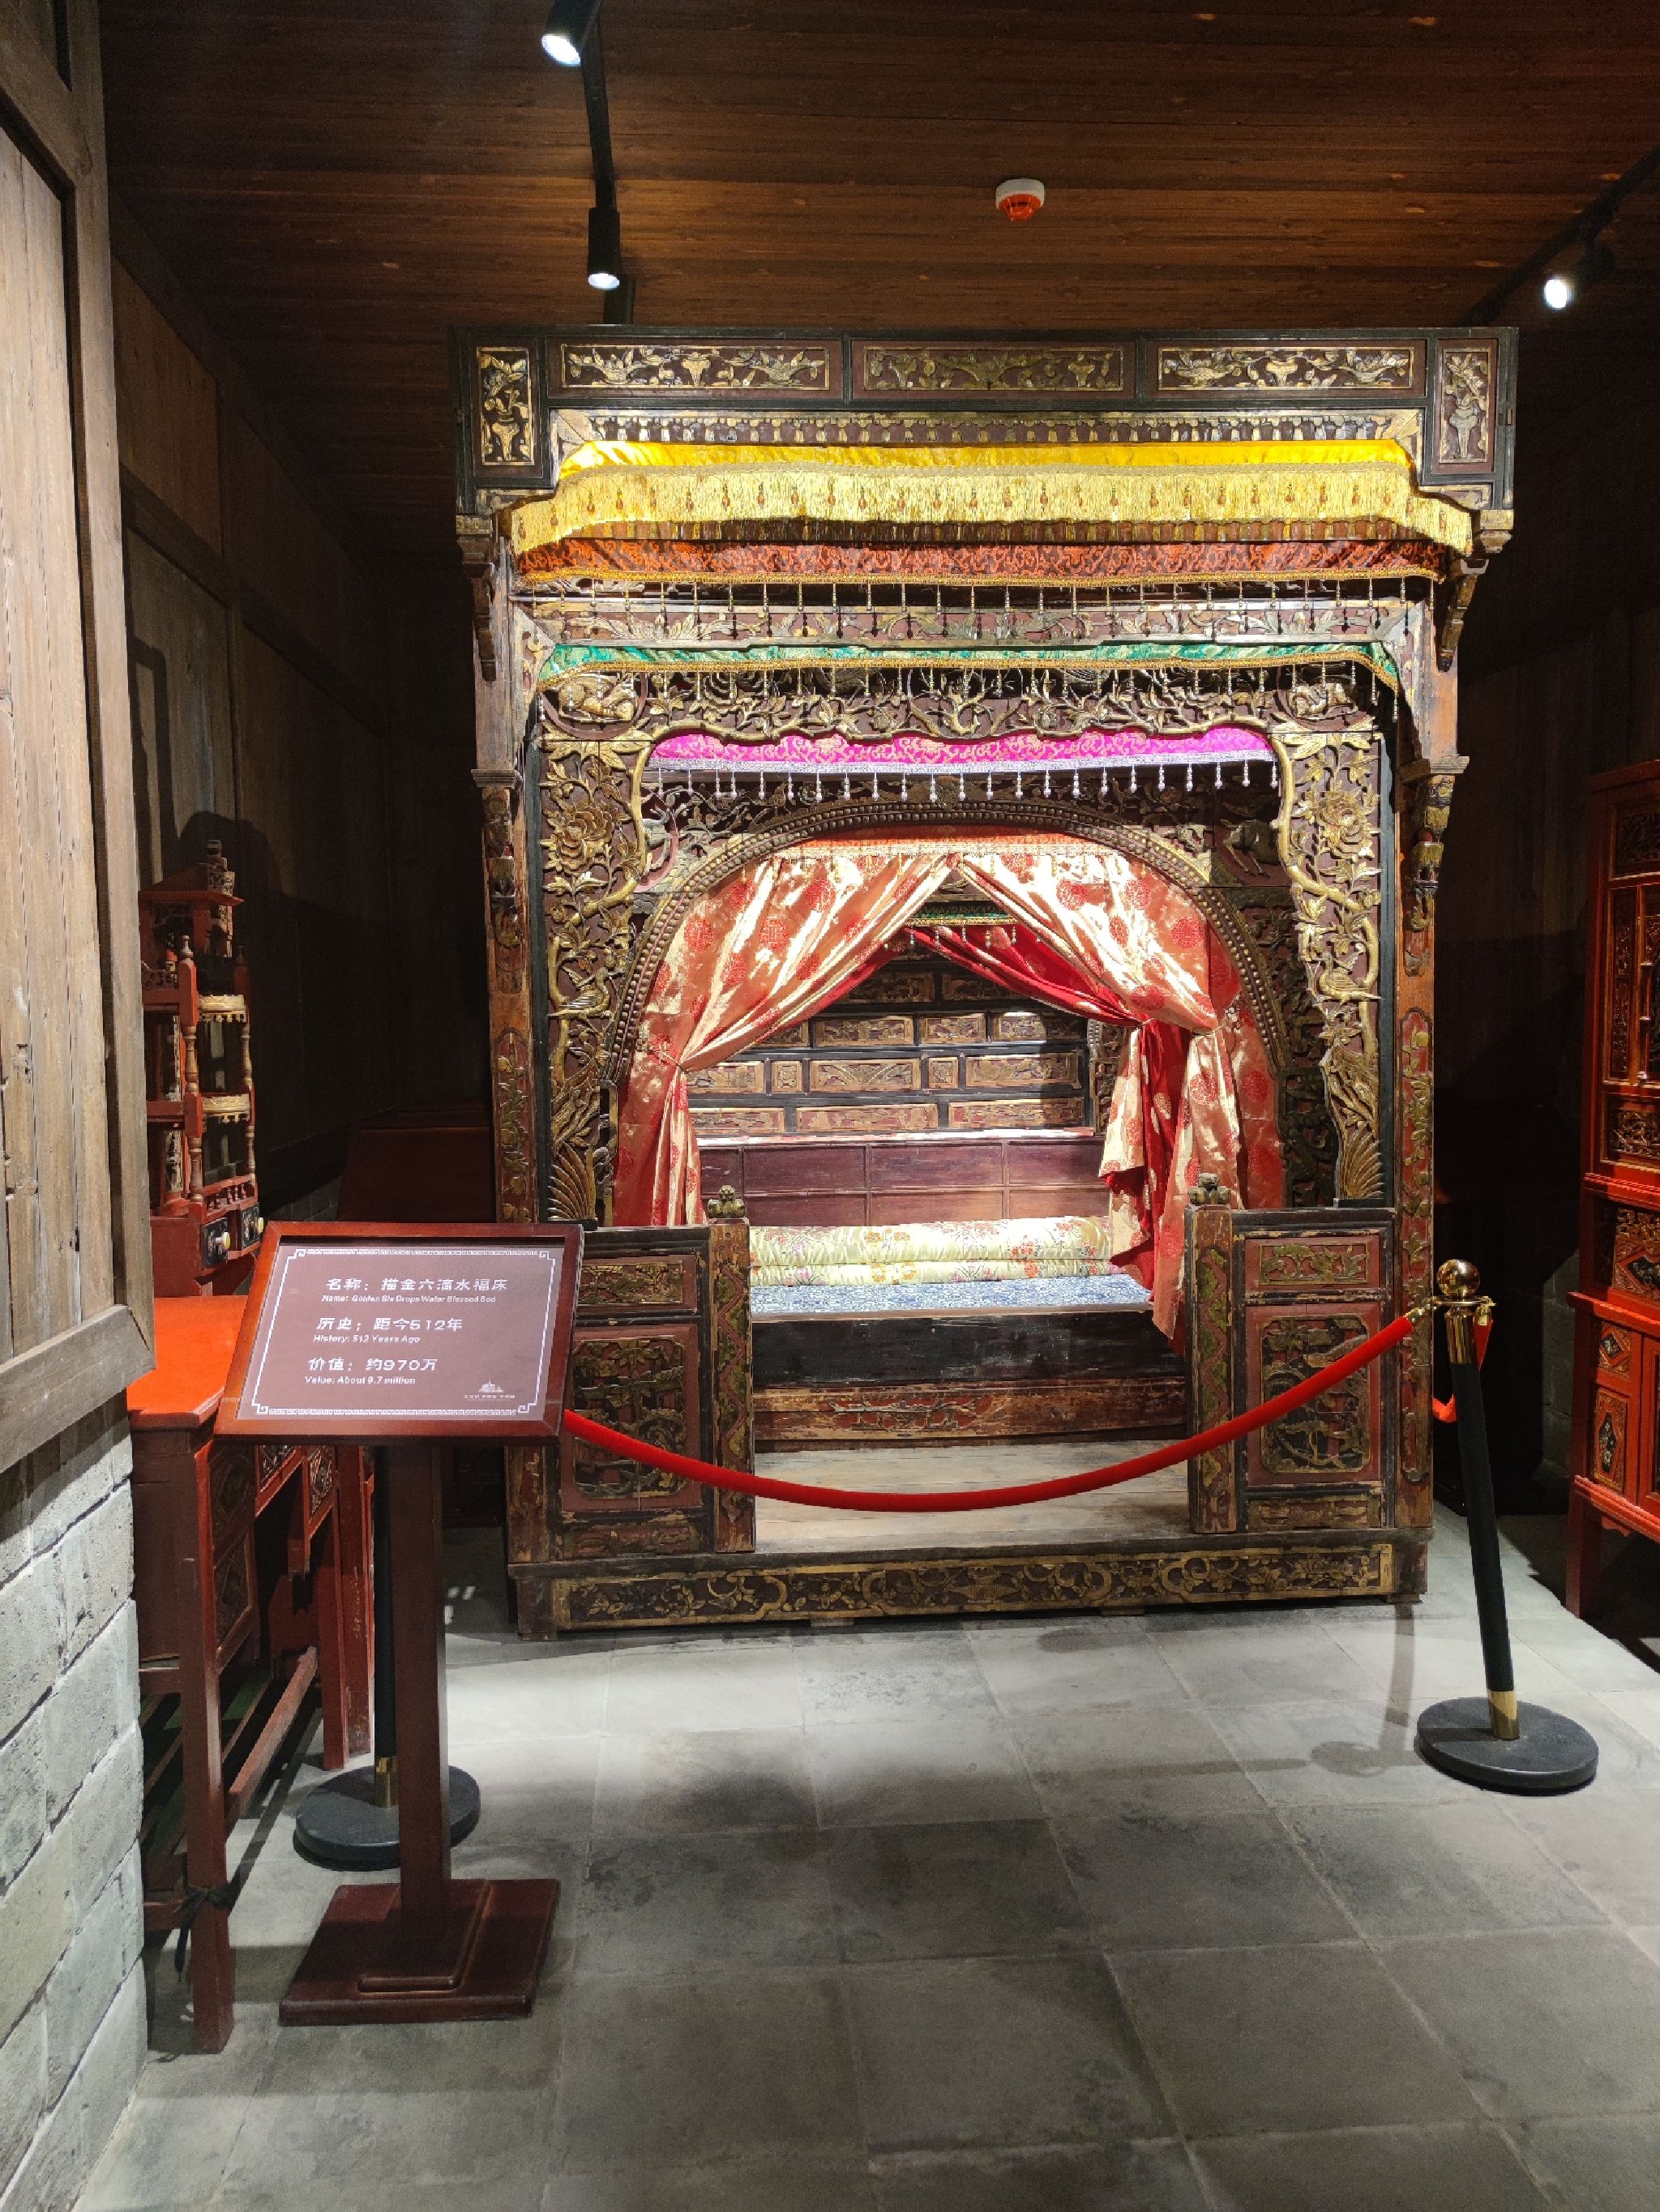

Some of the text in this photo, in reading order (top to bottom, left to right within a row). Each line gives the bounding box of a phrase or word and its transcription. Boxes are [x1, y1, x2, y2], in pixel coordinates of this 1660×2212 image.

[322, 1294, 349, 1303] Name:
[352, 1294, 380, 1303] Golden
[382, 1294, 395, 1303] Six
[396, 1294, 421, 1304] Drops
[421, 1294, 445, 1303] Water
[447, 1295, 479, 1303] Blessed
[313, 1334, 421, 1344] History: 512 Years Ago
[305, 1376, 416, 1384] Value: About 9.7 million
